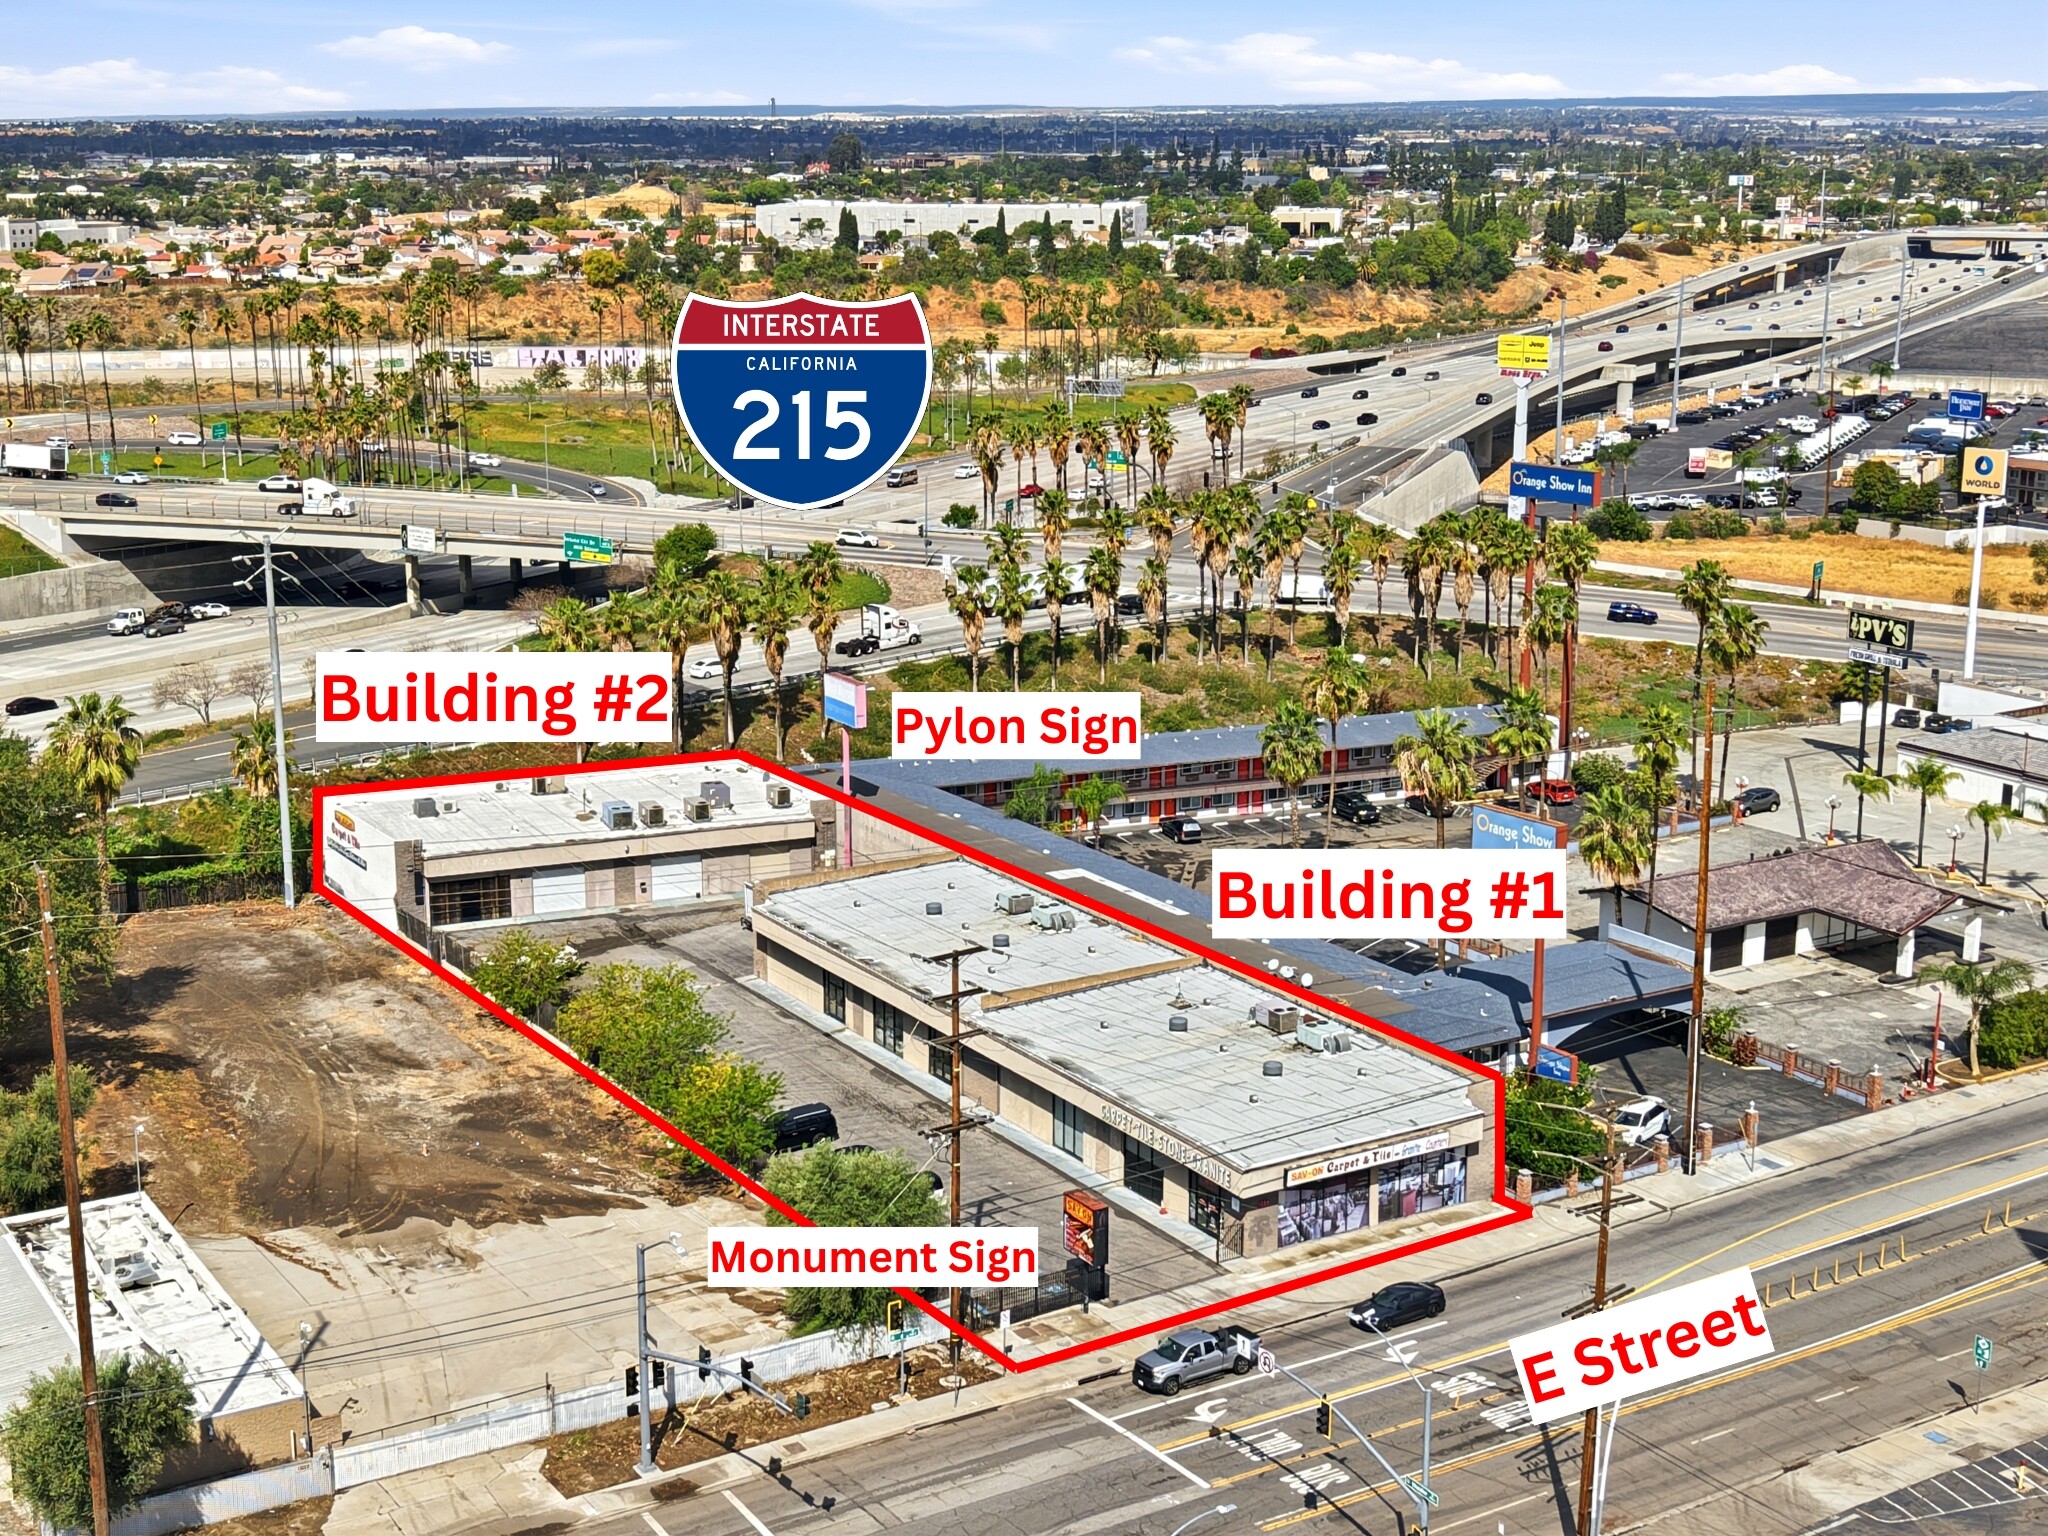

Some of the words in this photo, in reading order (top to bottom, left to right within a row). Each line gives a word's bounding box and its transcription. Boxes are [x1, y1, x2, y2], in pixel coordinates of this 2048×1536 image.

[1513, 470, 1547, 491] Orange
[1549, 475, 1575, 492] Show
[1577, 478, 1593, 494] Inn
[1965, 479, 2001, 489] WORLD
[1476, 814, 1518, 842] Orange
[1522, 825, 1553, 849] Show
[1291, 1165, 1325, 1181] SAV-ON
[1327, 1157, 1360, 1173] Carpet
[1372, 1151, 1391, 1163] Tile
